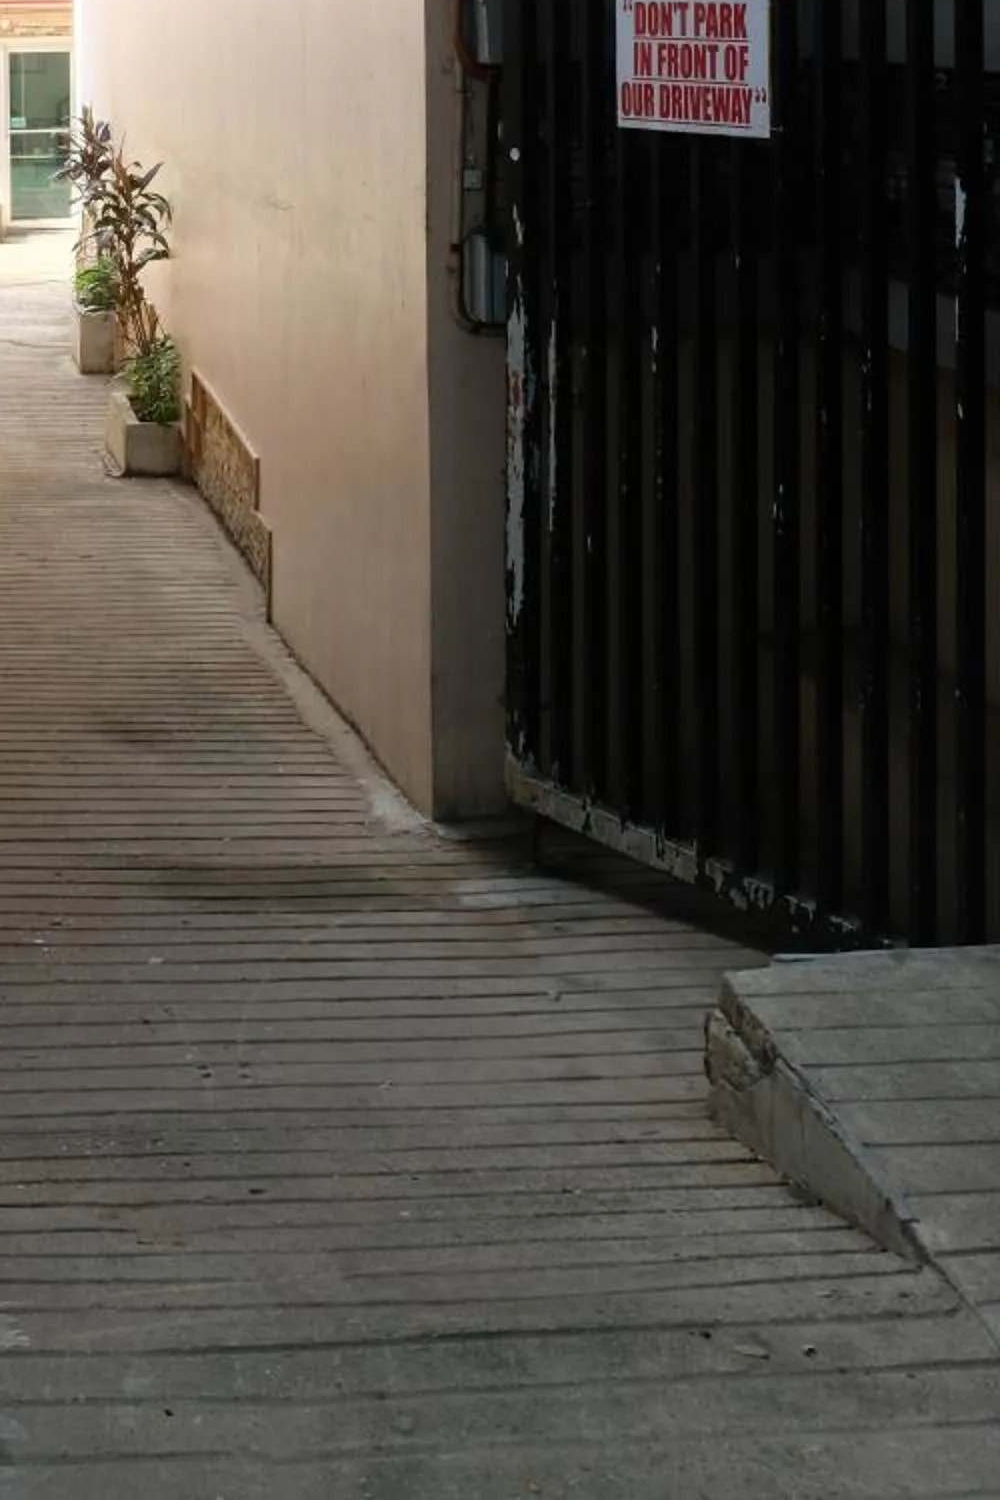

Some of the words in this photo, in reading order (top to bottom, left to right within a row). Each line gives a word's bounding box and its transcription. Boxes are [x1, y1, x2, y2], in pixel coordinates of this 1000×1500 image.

[694, 3, 746, 38] PARK
[633, 42, 651, 77] IN
[658, 43, 718, 79] FRONT
[724, 44, 749, 81] OF
[621, 82, 654, 117] OUR
